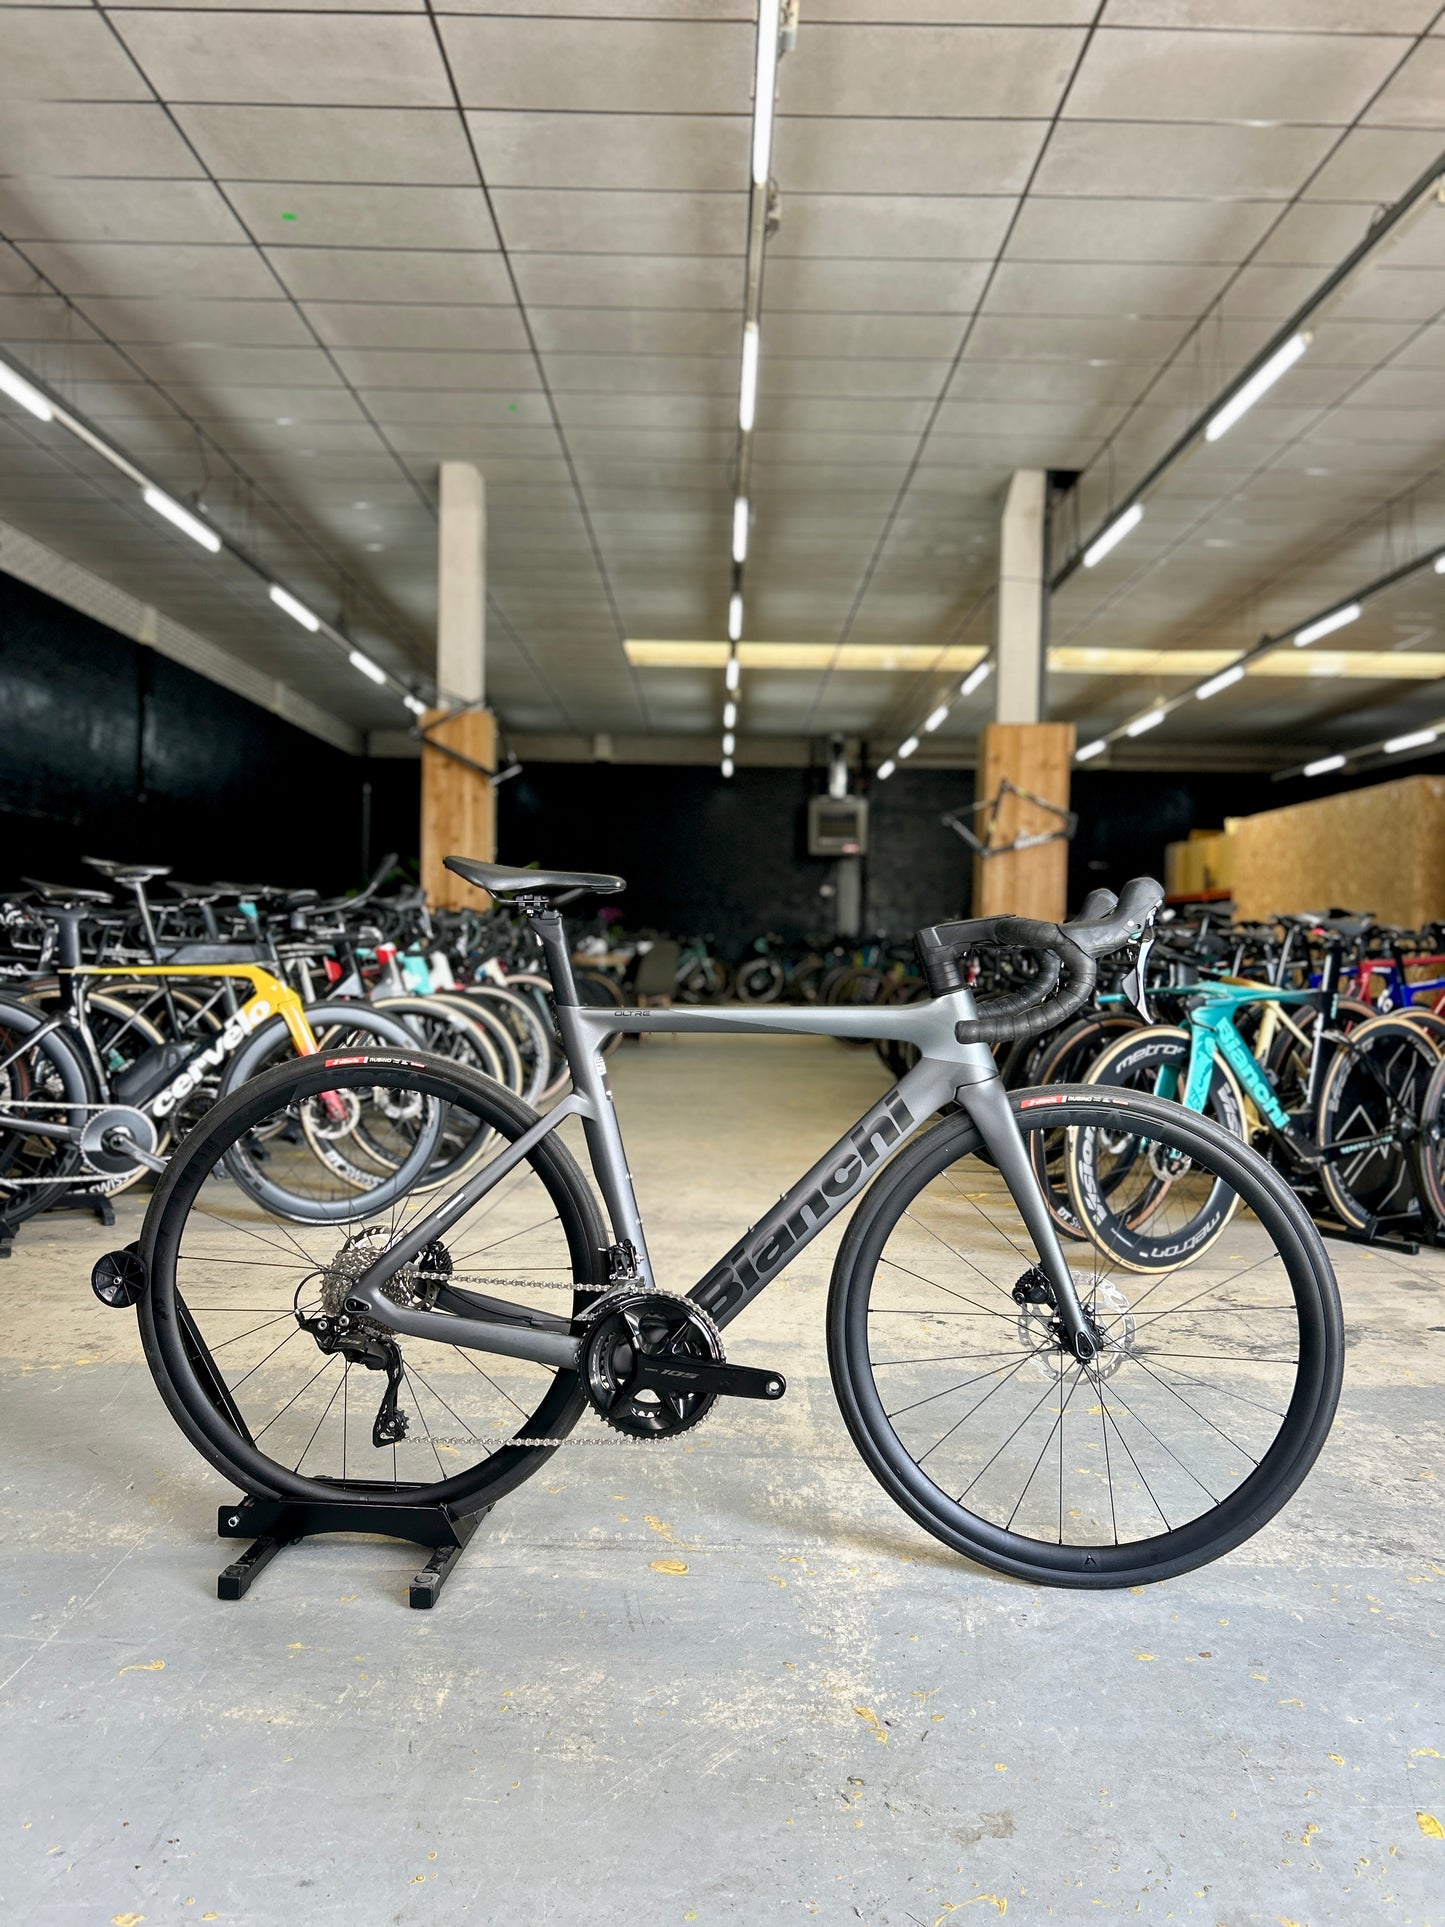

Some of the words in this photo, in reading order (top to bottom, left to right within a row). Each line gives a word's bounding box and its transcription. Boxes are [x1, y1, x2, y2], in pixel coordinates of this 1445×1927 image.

[1216, 1016, 1291, 1129] Bianchi
[694, 1090, 915, 1323] Bianchi
[1057, 1206, 1073, 1221] DT
[1151, 1211, 1221, 1258] metron
[660, 1367, 700, 1380] 105
